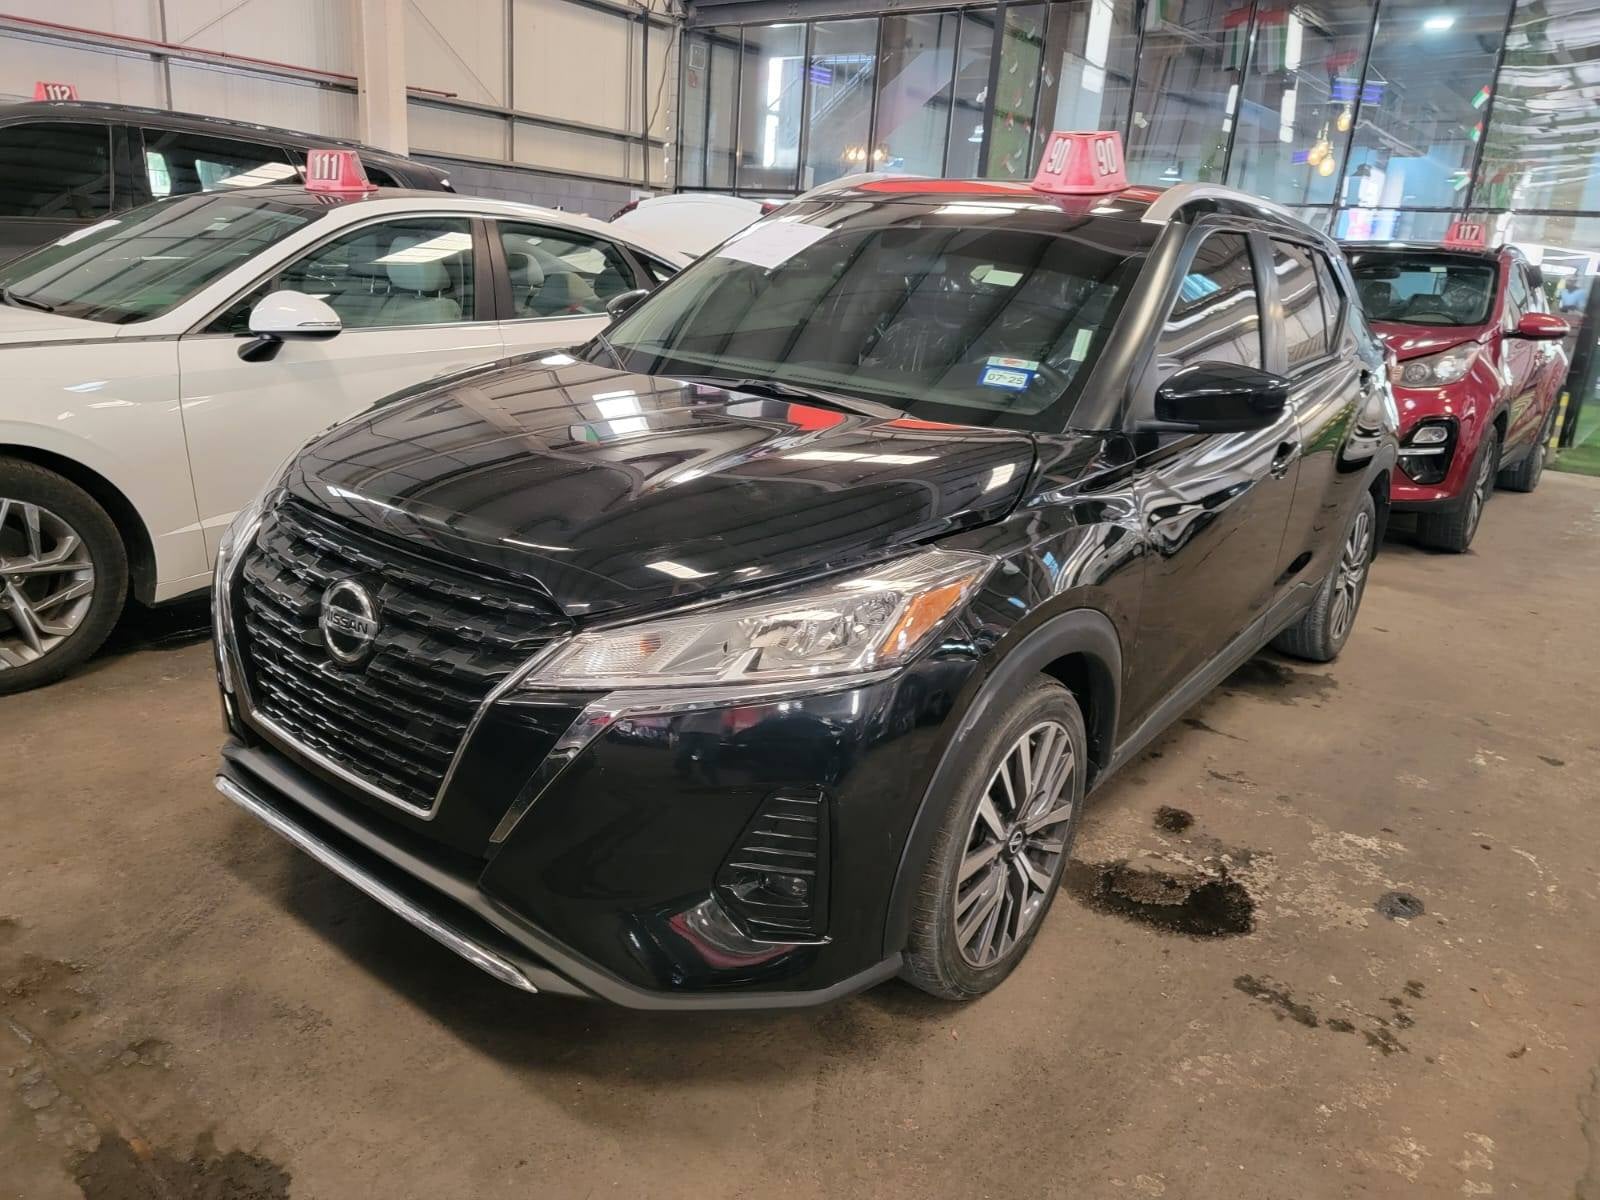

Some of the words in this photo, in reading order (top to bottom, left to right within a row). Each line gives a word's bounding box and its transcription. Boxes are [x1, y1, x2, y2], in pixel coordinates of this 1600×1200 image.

[46, 84, 71, 100] 112
[314, 153, 338, 180] 111
[1046, 137, 1072, 175] 90
[1095, 137, 1118, 176] 90
[1459, 224, 1480, 240] 117
[323, 608, 368, 634] NISSAN
